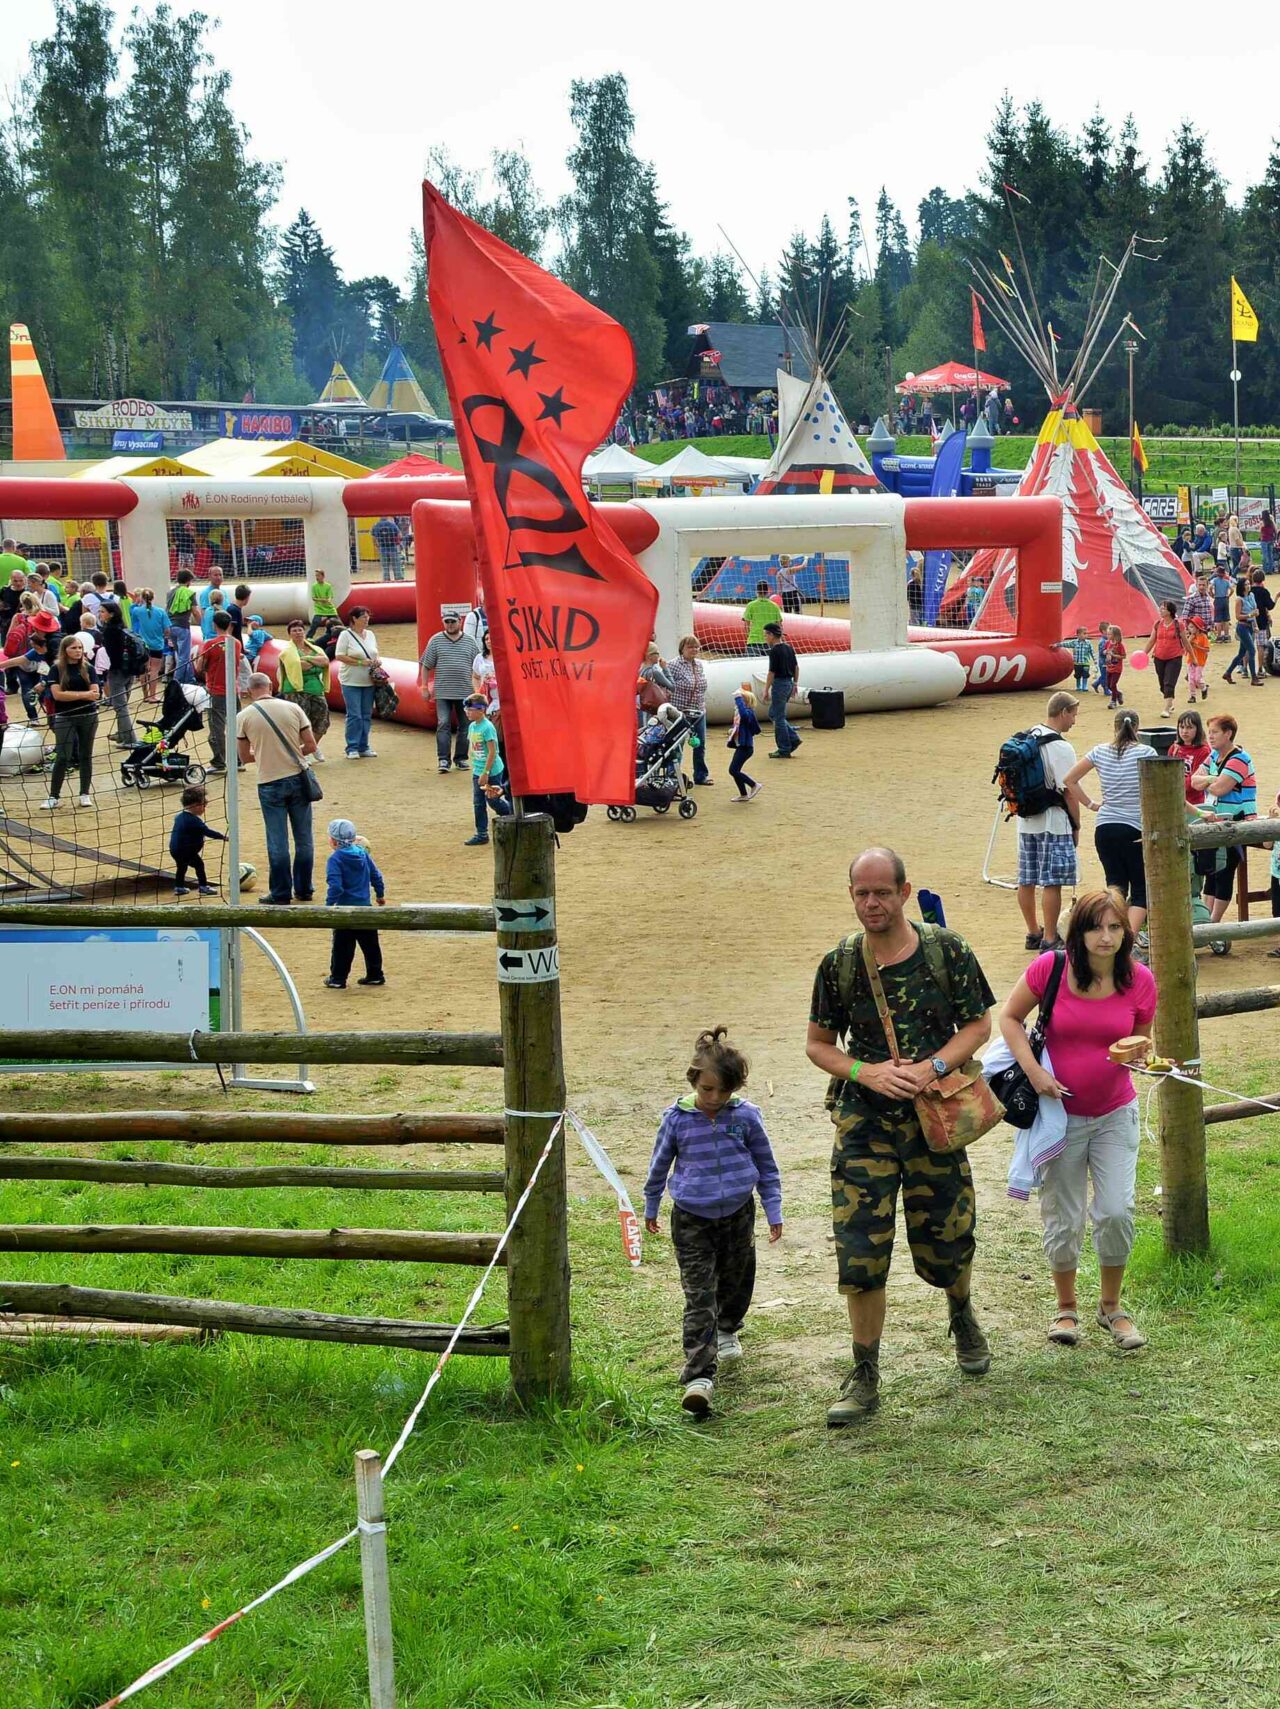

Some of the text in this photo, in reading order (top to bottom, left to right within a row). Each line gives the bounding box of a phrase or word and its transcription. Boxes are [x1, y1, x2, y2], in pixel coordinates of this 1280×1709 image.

[112, 400, 155, 417] RODEO
[241, 416, 292, 434] HARIBO
[231, 493, 268, 508] Rodinný
[270, 492, 309, 505] fotbálek
[1142, 499, 1176, 516] CARS
[50, 984, 144, 998] E.ON mi pomáhá
[49, 999, 79, 1011] šetřit
[82, 999, 120, 1013] peníze
[129, 999, 170, 1012] přírodu
[626, 1216, 641, 1257] CAMS
